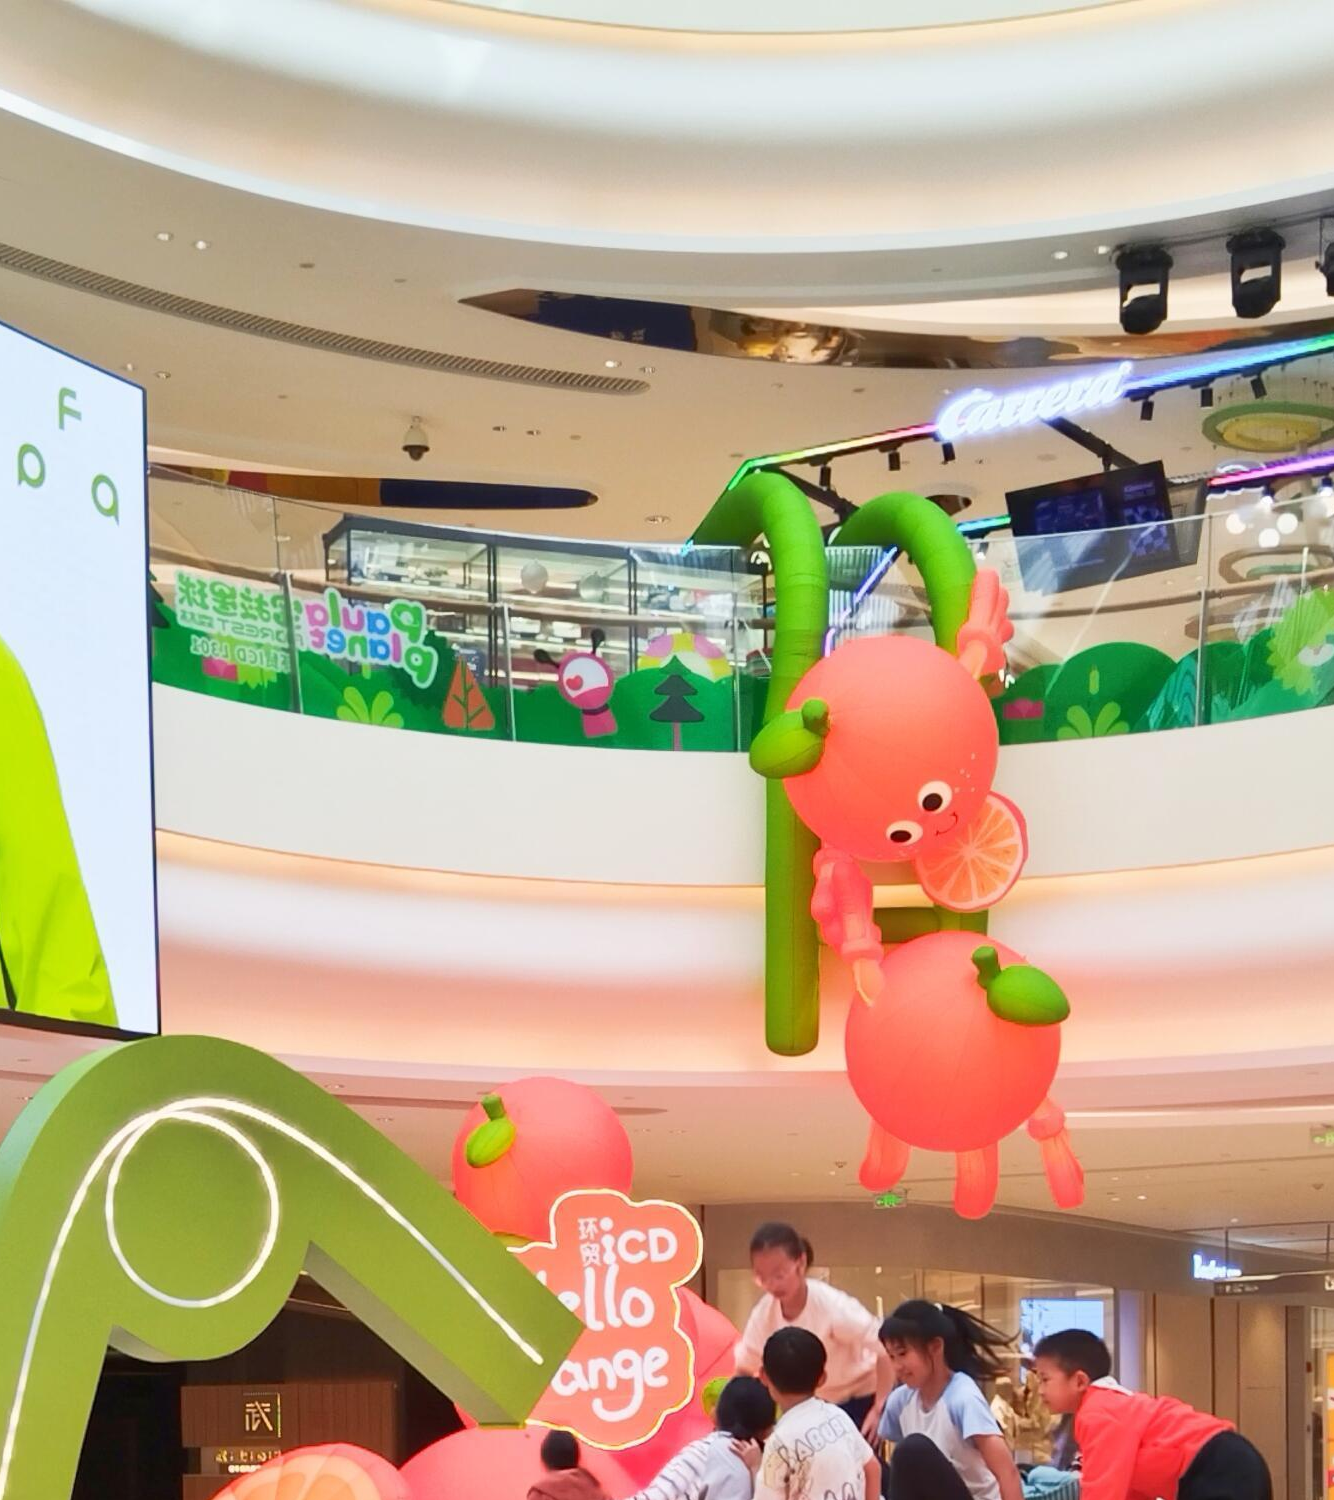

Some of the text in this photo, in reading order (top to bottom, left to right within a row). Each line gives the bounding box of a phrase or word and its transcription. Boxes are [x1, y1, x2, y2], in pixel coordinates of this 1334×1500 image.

[937, 360, 1134, 441] Carrera
[577, 1217, 602, 1268] 环贸
[599, 1216, 678, 1265] iCD
[536, 1263, 655, 1331] llo
